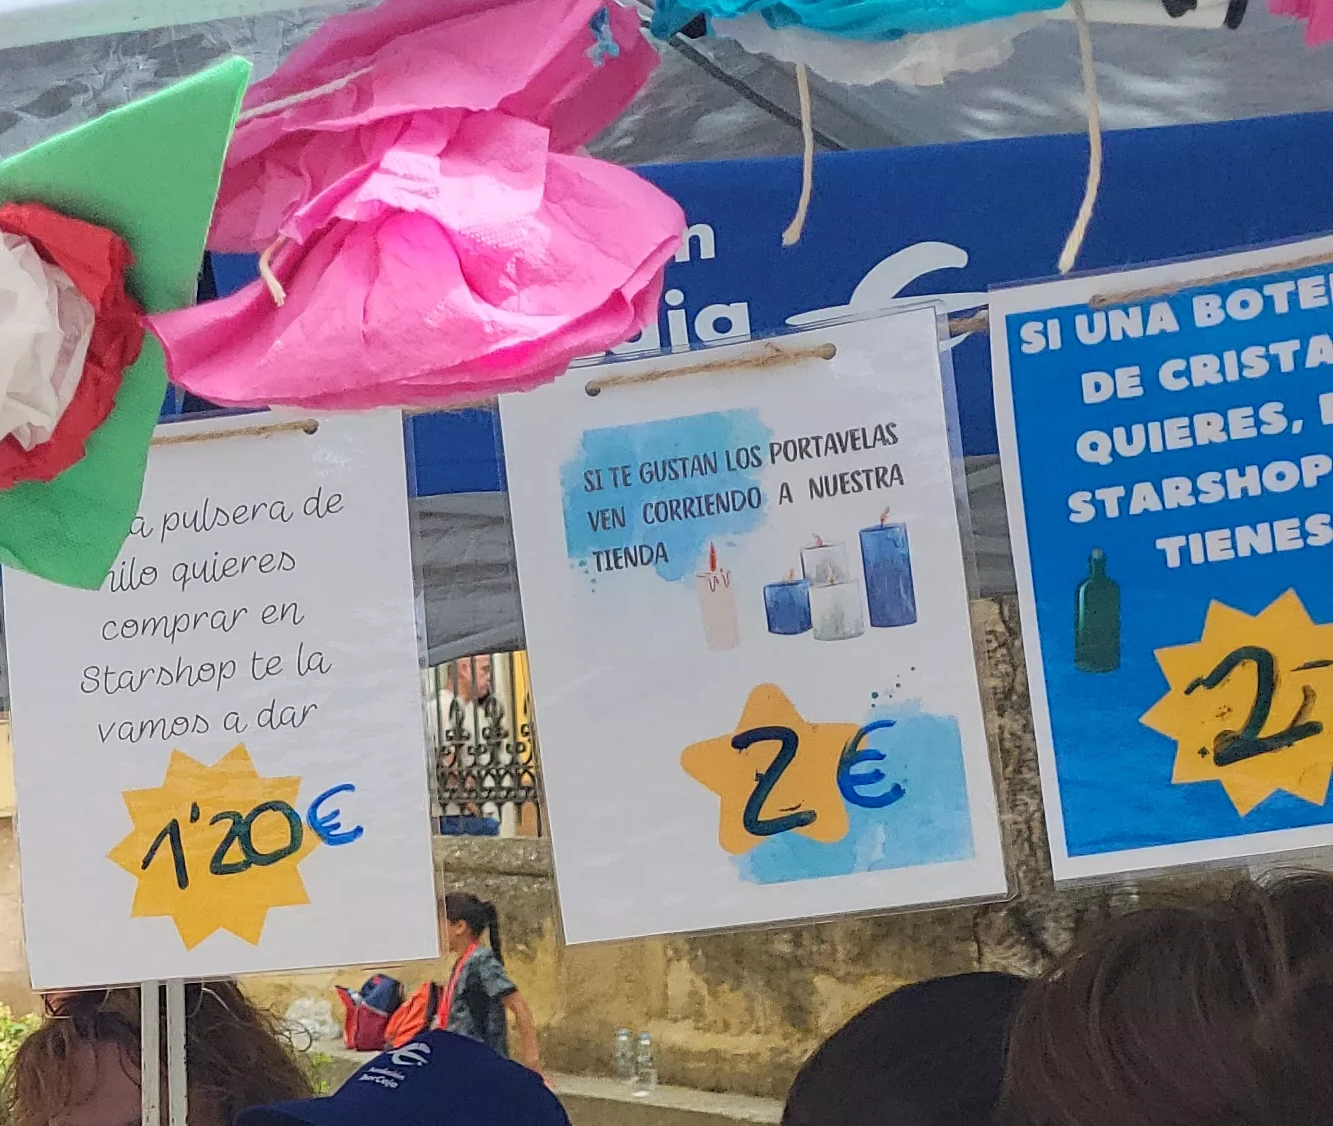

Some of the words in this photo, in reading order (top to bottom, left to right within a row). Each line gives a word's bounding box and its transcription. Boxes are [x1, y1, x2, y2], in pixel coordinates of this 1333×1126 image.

[1019, 318, 1062, 354] SI
[1075, 301, 1180, 346] UNA
[1192, 273, 1333, 328] BOTE
[1081, 365, 1144, 404] DE
[1158, 333, 1333, 392] CRISTA
[583, 468, 605, 492] SI
[608, 465, 631, 488] TE
[639, 451, 718, 485] GUSTAN
[725, 445, 763, 472] LOS
[769, 421, 900, 465] PORTAVELAS
[1075, 401, 1304, 466] QUIERES,
[161, 497, 293, 543] pulsera
[303, 486, 344, 519] de
[587, 506, 626, 533] VEN
[642, 486, 762, 525] CORRIENDO
[778, 482, 793, 505] A
[809, 463, 905, 501] NUESTRA
[1068, 454, 1333, 524] STARSHOP
[592, 541, 669, 573] TIENDA
[1155, 513, 1333, 569] TIENES
[172, 551, 296, 592] quieres
[102, 607, 248, 644] comprar
[261, 601, 305, 625] en
[80, 656, 237, 694] Starshop
[251, 651, 283, 681] te
[296, 642, 333, 676] la
[97, 714, 210, 743] vamos
[223, 711, 248, 734] a
[257, 698, 318, 730] dar
